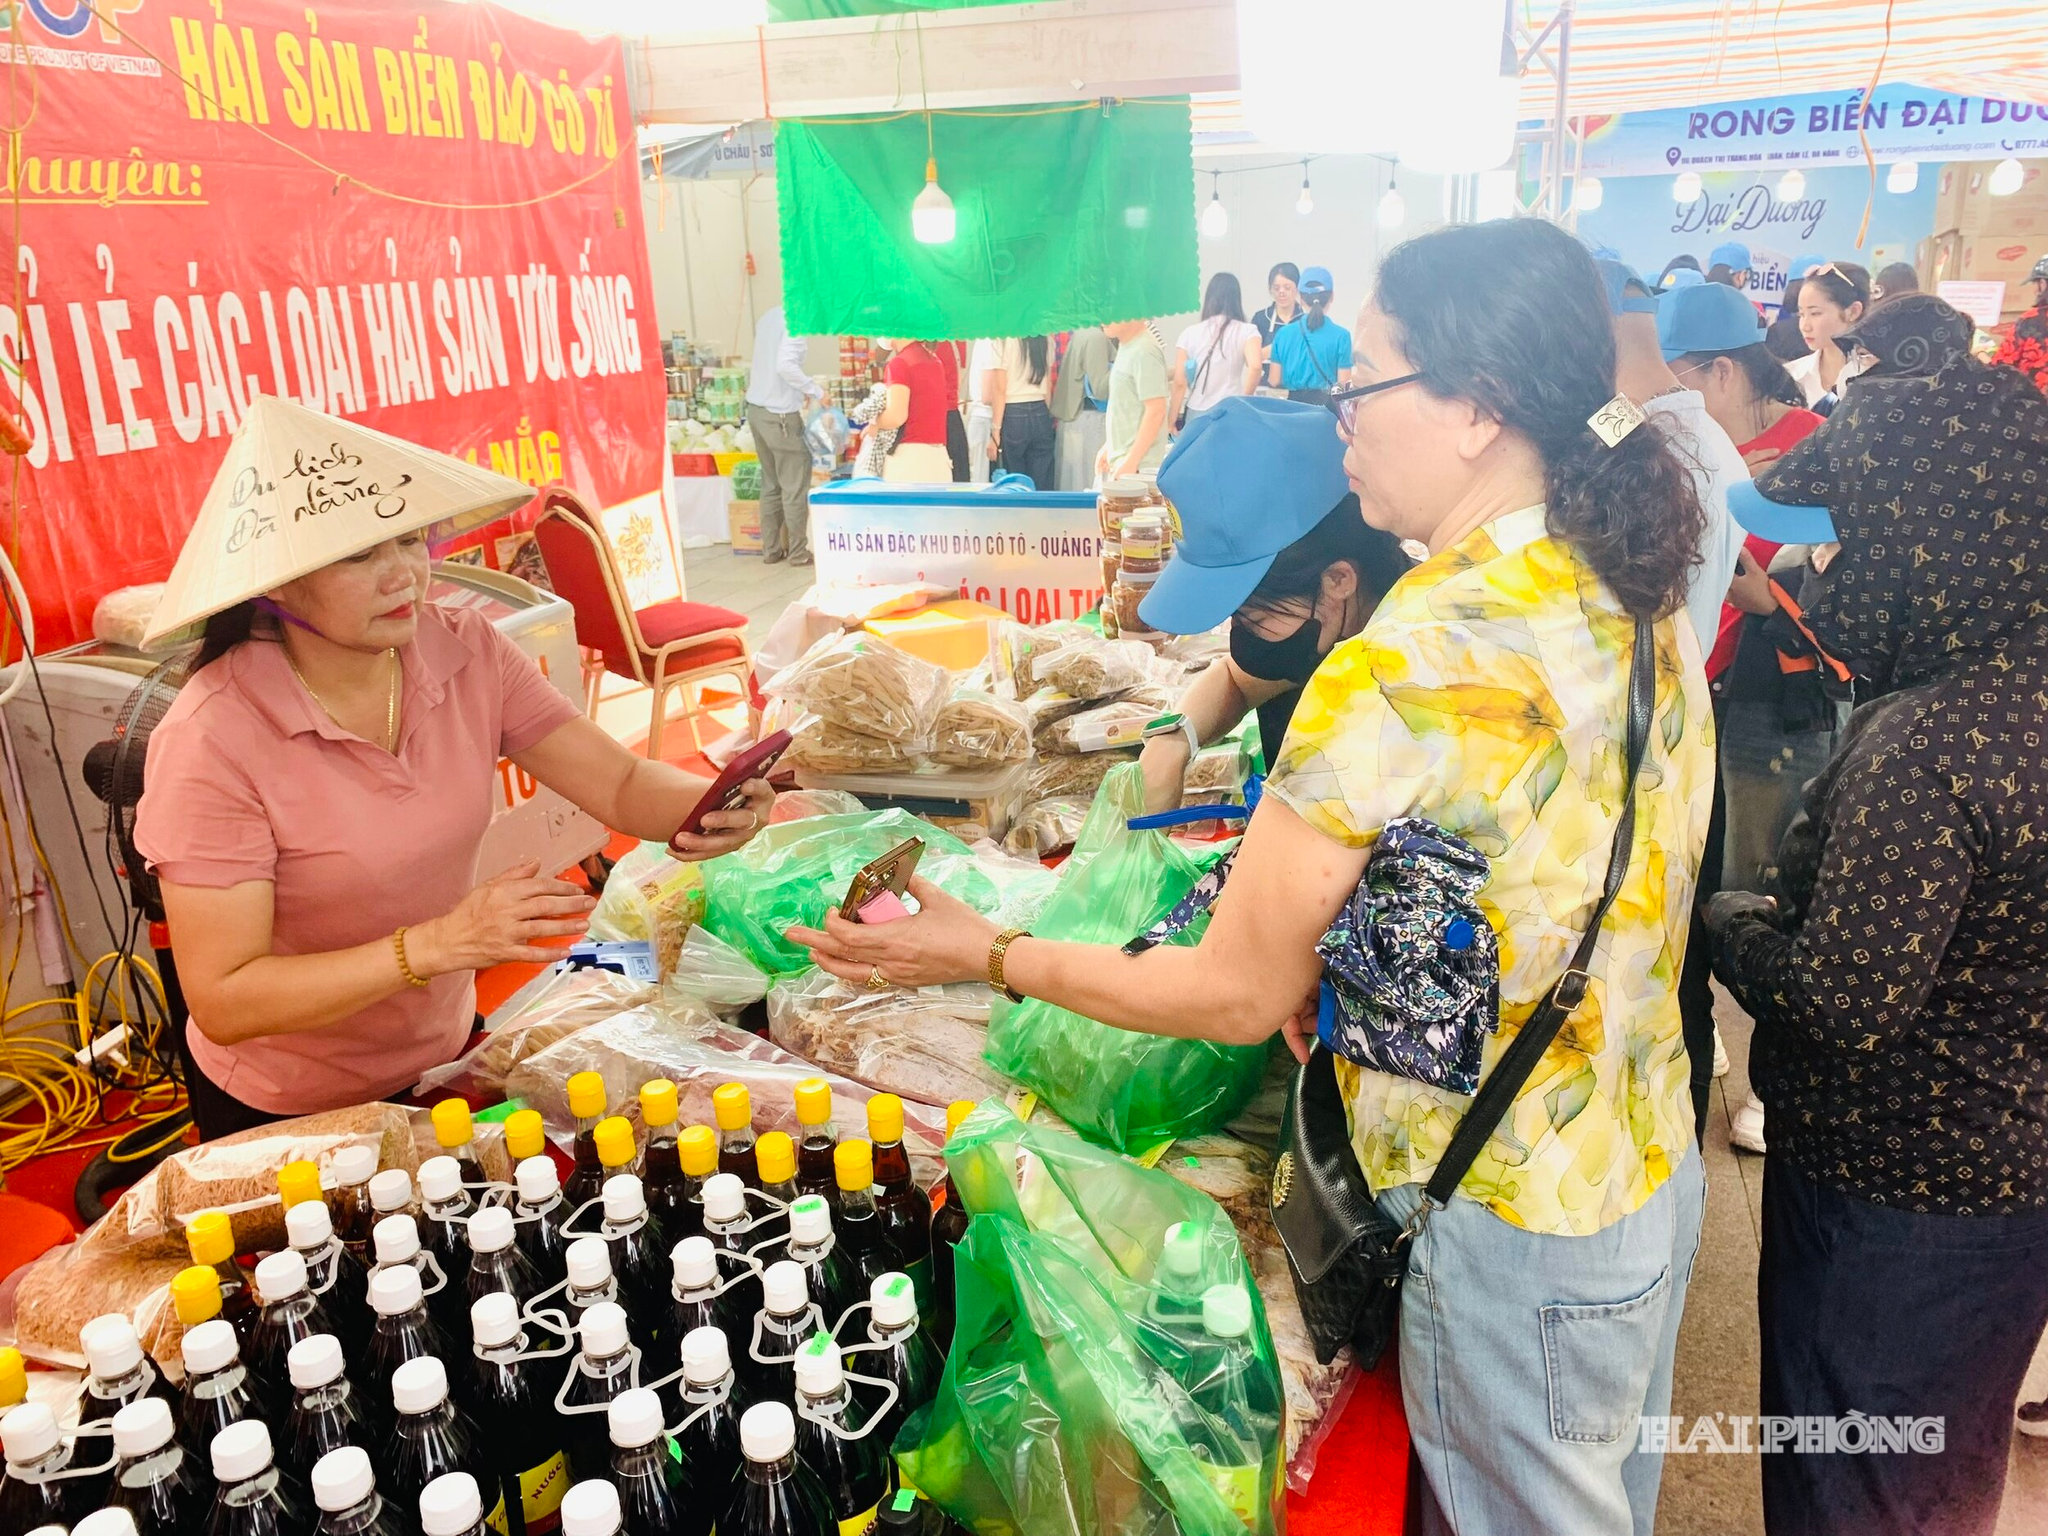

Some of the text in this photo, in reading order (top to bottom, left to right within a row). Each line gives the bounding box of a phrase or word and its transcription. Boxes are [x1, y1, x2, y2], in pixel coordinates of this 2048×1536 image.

[170, 0, 270, 124] HẢI
[275, 8, 372, 132] SẢN
[373, 15, 464, 139] BIỂN
[467, 41, 537, 149] ĐẢO
[541, 68, 586, 156] CÔ
[1687, 106, 1796, 140] RONG
[1808, 87, 1888, 133] BIỂN
[1901, 97, 1969, 135] ĐẠI
[0, 130, 203, 208] huyên:
[1750, 262, 1788, 292] BIỂN
[66, 242, 159, 457] LẺ
[153, 261, 261, 443] CÁC
[360, 237, 435, 408] HẢI
[432, 235, 510, 397] SẢN
[569, 237, 643, 379] SỐNG
[828, 526, 852, 552] HẢI
[855, 526, 884, 553] SẢN
[887, 530, 916, 559] ĐẶC
[920, 534, 948, 555] KHU
[952, 528, 981, 555] ĐẢO
[986, 531, 1004, 556] CÔ
[1009, 531, 1026, 556] TÔ
[1040, 529, 1092, 559] QUẢNG
